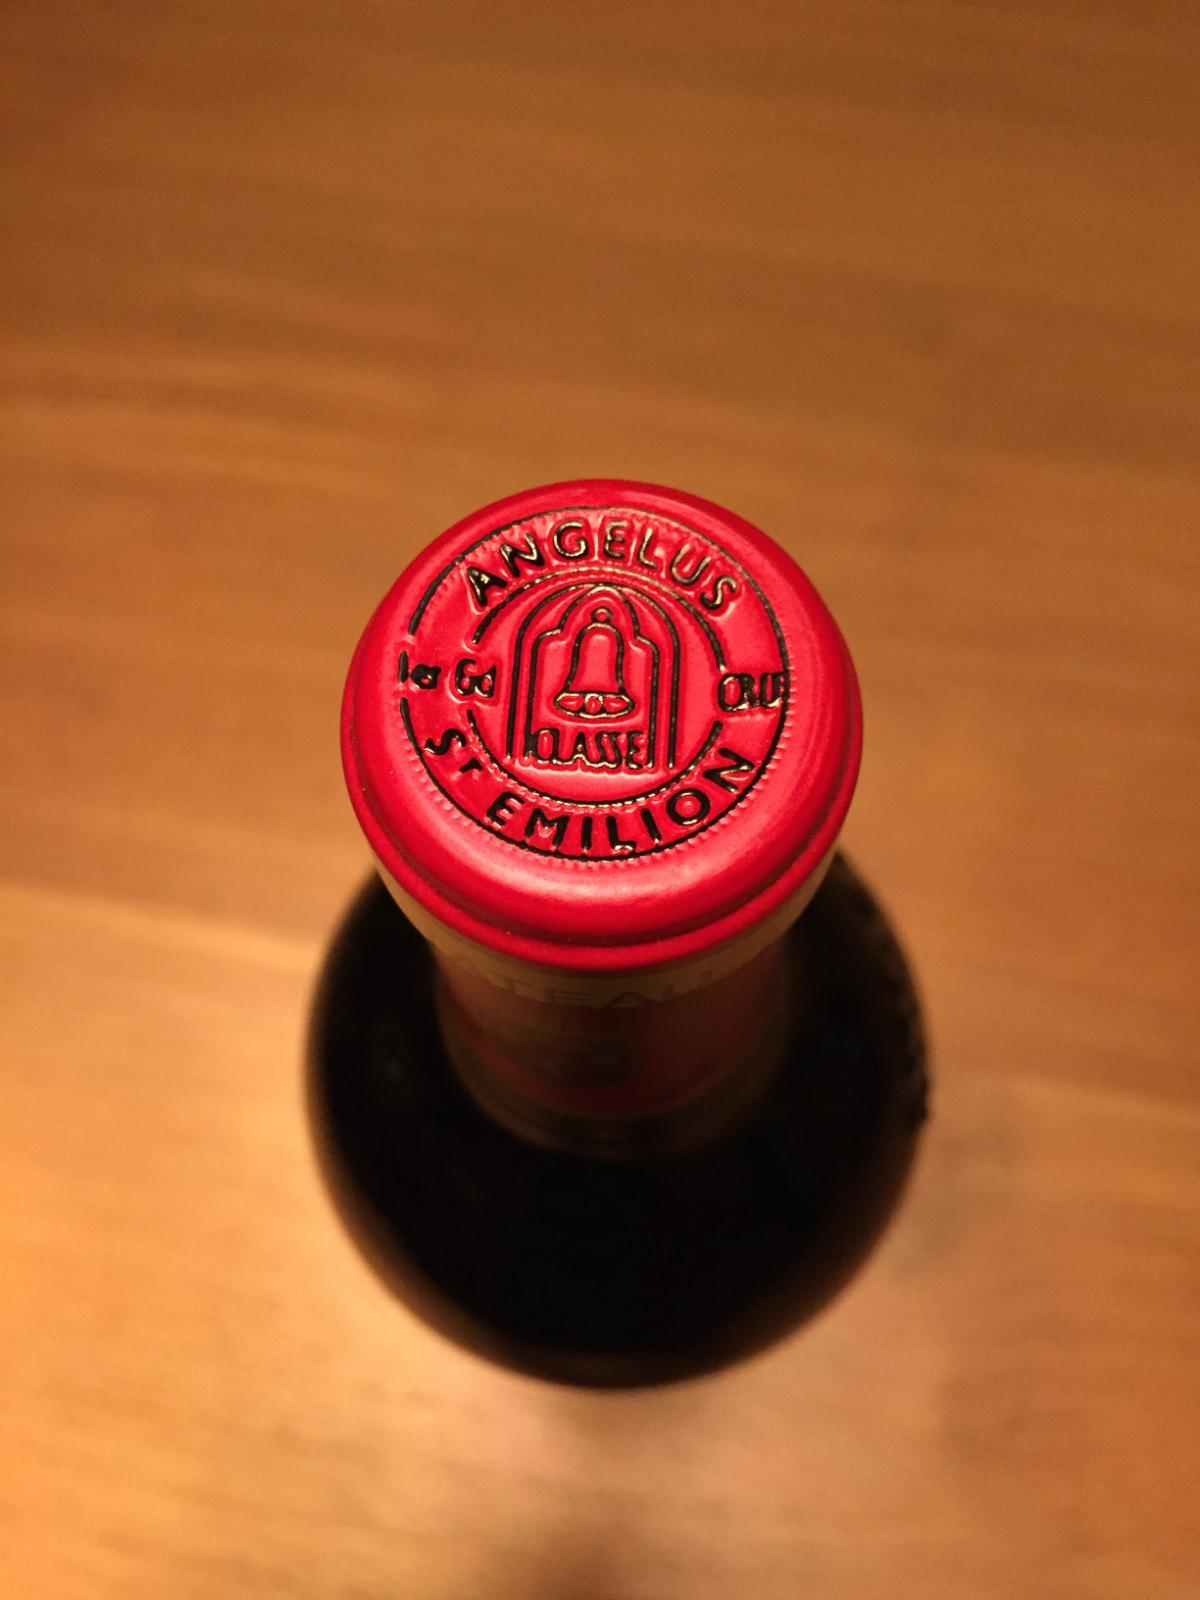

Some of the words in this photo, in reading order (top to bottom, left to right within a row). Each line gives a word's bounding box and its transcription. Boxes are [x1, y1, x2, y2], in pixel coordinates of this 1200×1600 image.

[467, 521, 737, 610] ANGELUS
[531, 728, 643, 769] CLASSE
[484, 747, 755, 853] EMILION
